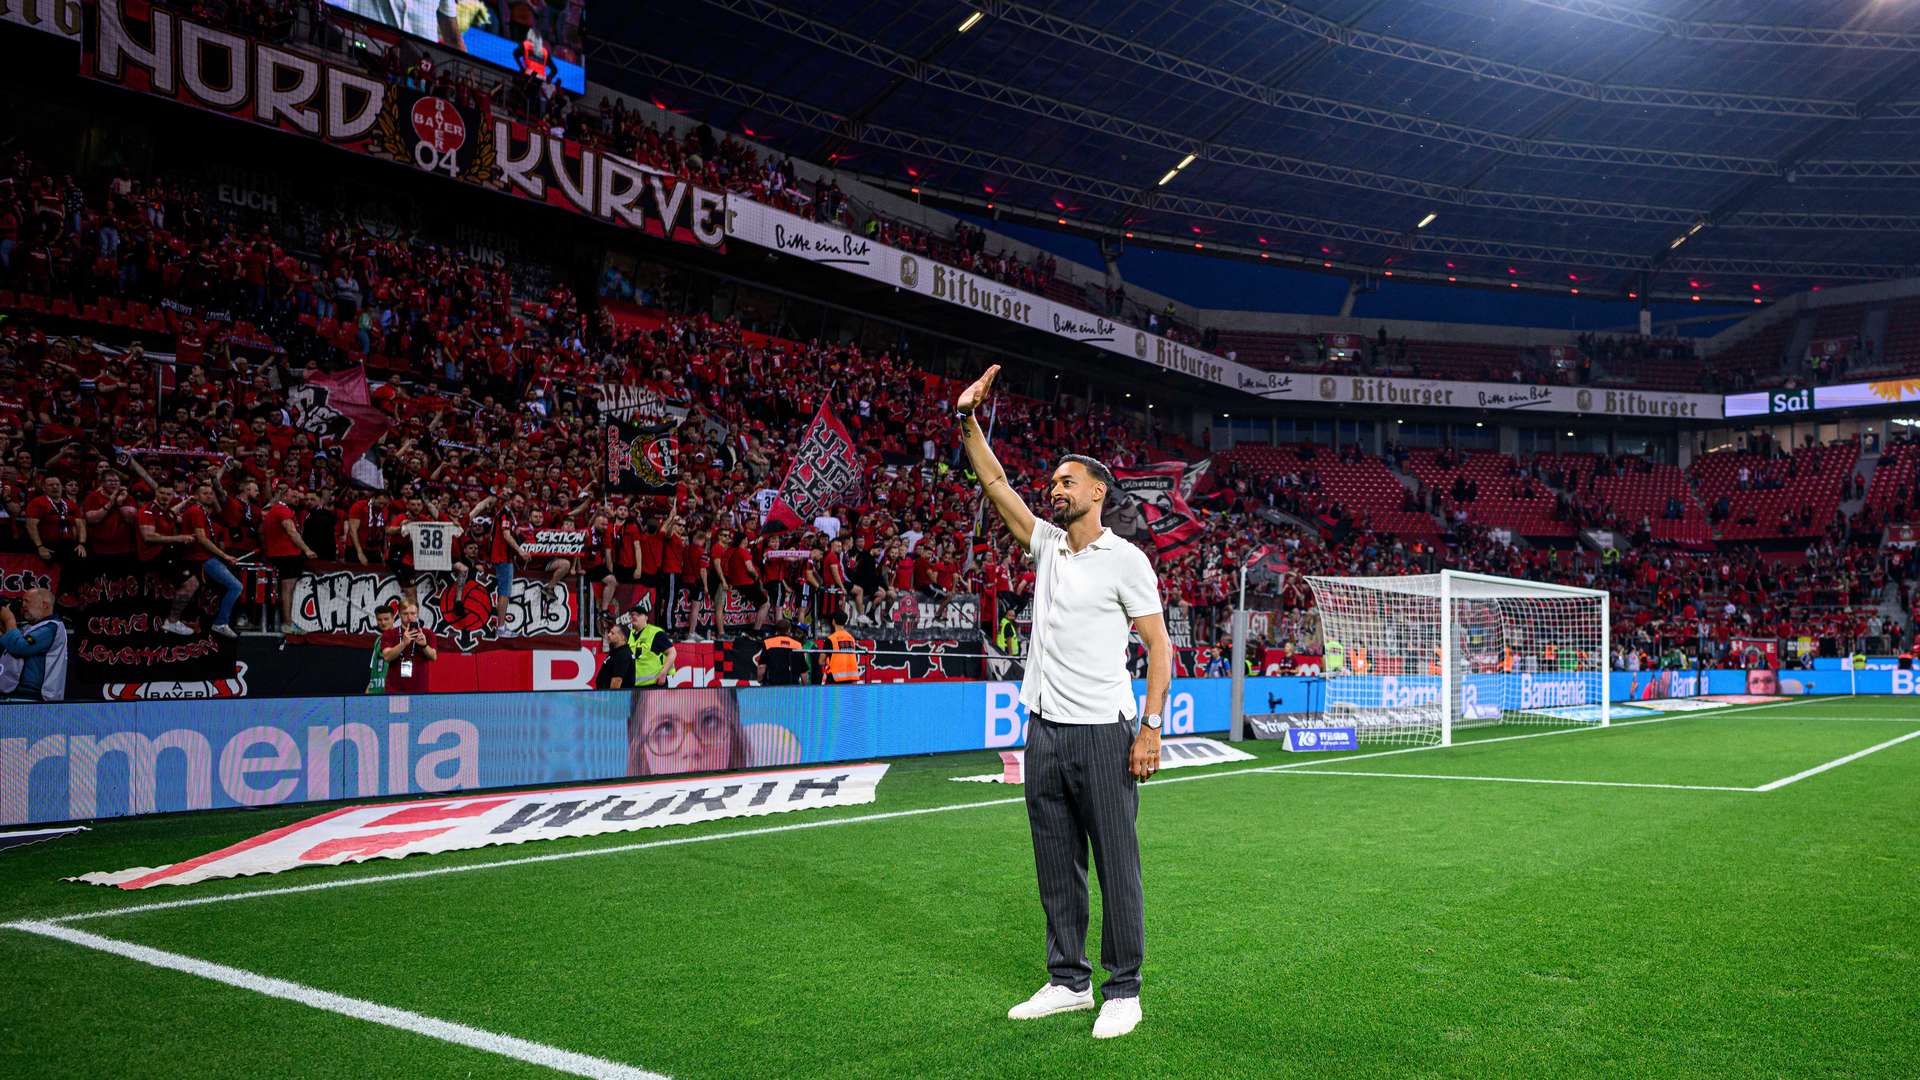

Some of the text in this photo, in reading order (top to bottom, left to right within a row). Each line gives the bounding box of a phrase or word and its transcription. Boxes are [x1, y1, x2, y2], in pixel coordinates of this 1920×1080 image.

[414, 112, 463, 137] BAYER
[415, 140, 460, 177] 04
[494, 118, 726, 248] KURVE
[217, 183, 278, 214] EUCH
[775, 224, 871, 257] Bitte ein Bit
[469, 244, 505, 268] UNS
[932, 263, 1032, 324] Bitburger
[1053, 312, 1116, 336] Bitte ein Bit
[1155, 338, 1224, 382] Bitburger
[1268, 374, 1293, 389] Bit
[1352, 377, 1454, 406] Bitburger
[1478, 386, 1552, 406] Bitte ein Bit
[1604, 391, 1699, 418] Bitburger
[1773, 389, 1810, 413] Sai
[420, 528, 443, 550] 38
[535, 530, 587, 545] SEKTION
[1520, 670, 1586, 710] Barmenia
[0, 695, 480, 825] rmenia
